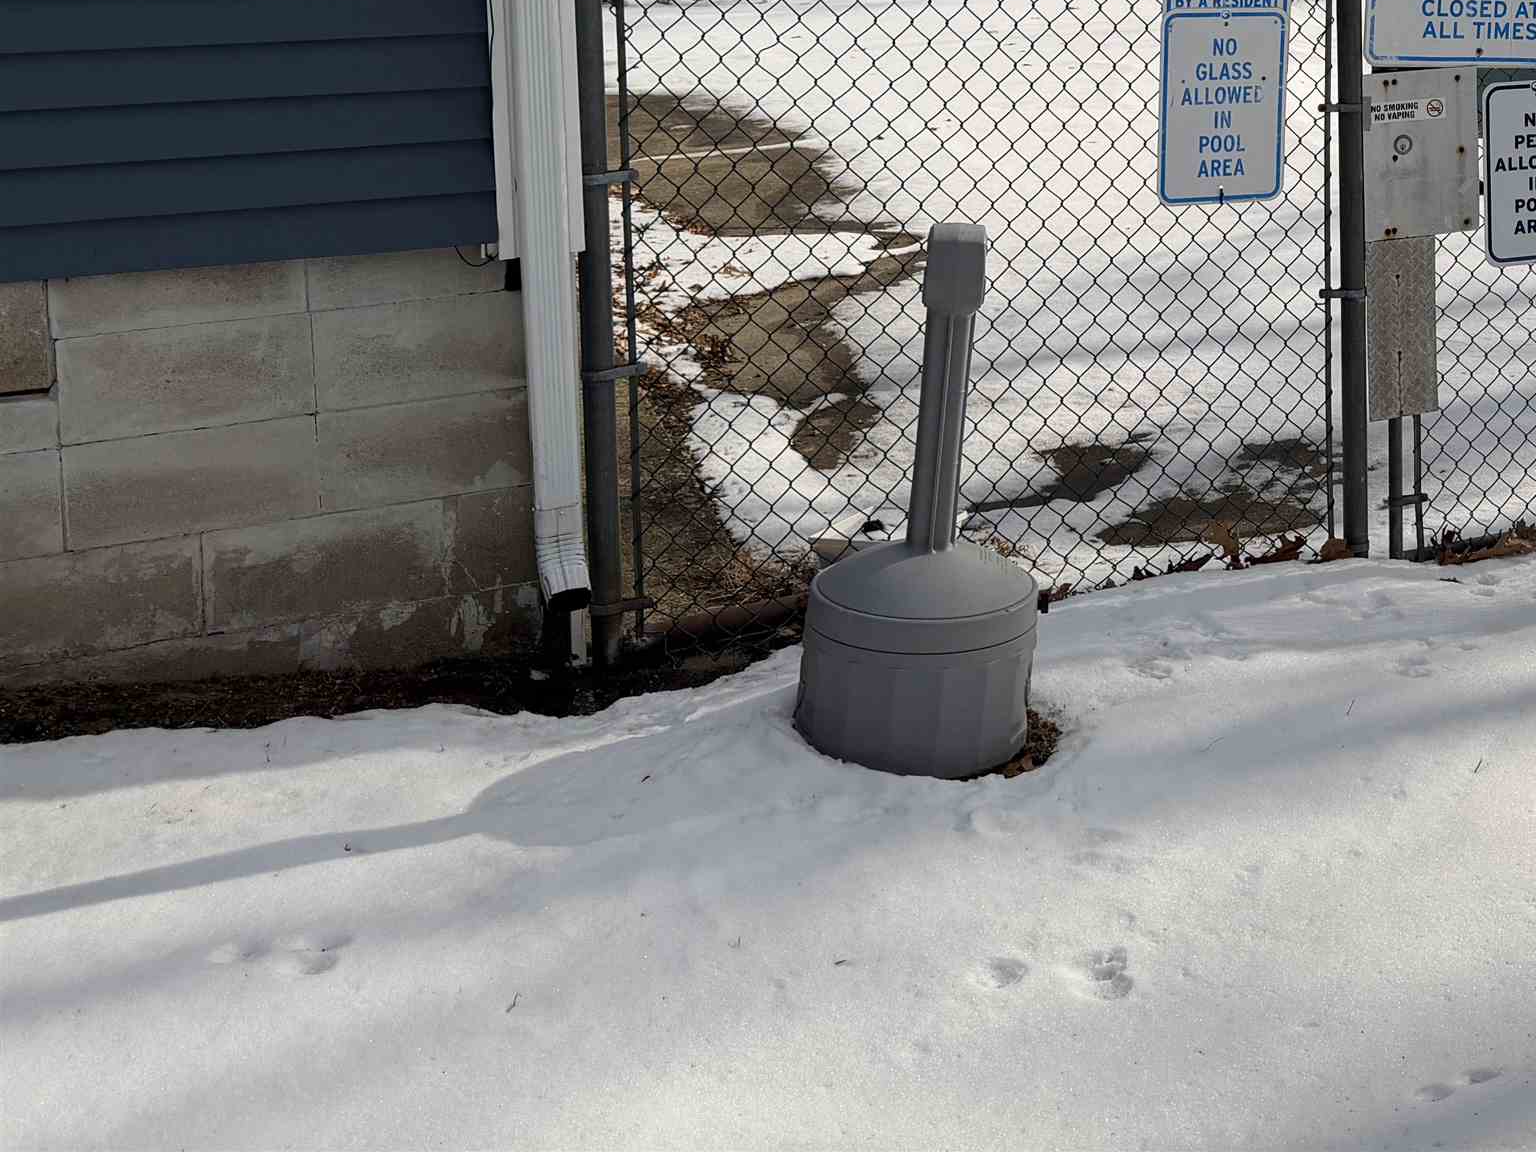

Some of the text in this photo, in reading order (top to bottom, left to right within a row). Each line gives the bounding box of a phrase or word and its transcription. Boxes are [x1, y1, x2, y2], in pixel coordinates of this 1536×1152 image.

[1422, 0, 1507, 18] CLOSED
[1423, 21, 1465, 39] ALL
[1213, 38, 1237, 56] NO
[1196, 63, 1253, 81] GLASS
[1370, 102, 1418, 113] NO SMOKING
[1375, 110, 1415, 121] NO VAPING
[1214, 111, 1232, 129] IN
[1199, 136, 1246, 154] POOL
[1198, 159, 1245, 178] AREA
